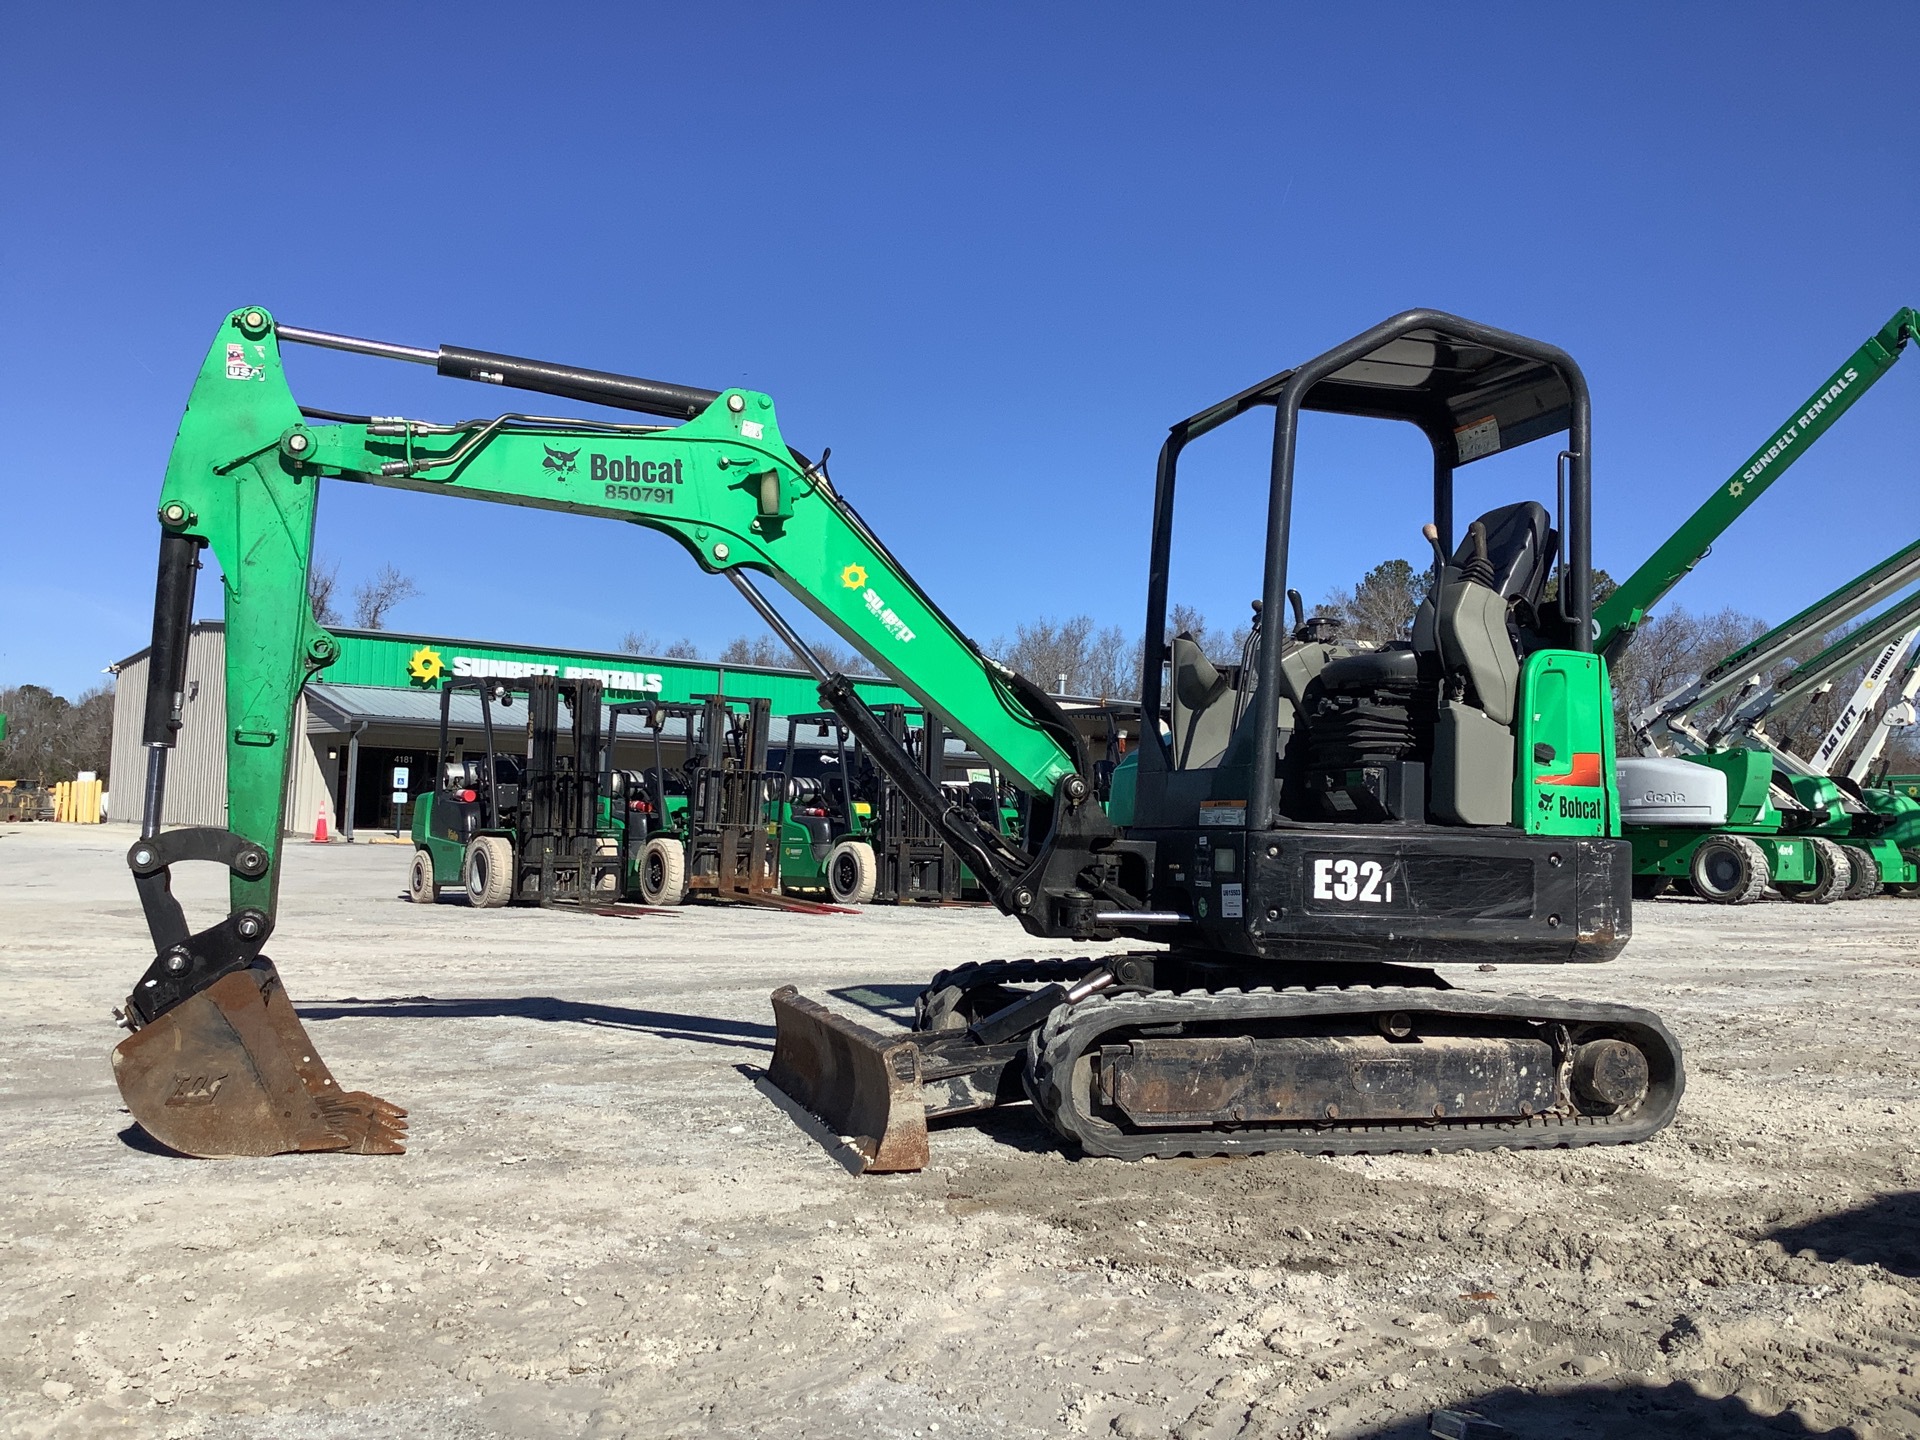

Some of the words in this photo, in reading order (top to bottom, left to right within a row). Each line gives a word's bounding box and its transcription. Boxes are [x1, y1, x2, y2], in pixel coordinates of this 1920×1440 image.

[1743, 425, 1799, 483] SUNBELT
[1797, 367, 1859, 429] RENTALS
[590, 453, 683, 484] Bobcat
[605, 485, 673, 504] 850791
[1871, 644, 1896, 680] SUNBELT
[1820, 734, 1839, 761] JLG
[1836, 705, 1857, 737] LIFT
[394, 755, 413, 763] 4181
[1560, 795, 1601, 819] Bobcat
[1644, 790, 1686, 803] Genie
[1778, 844, 1793, 856] 4x4
